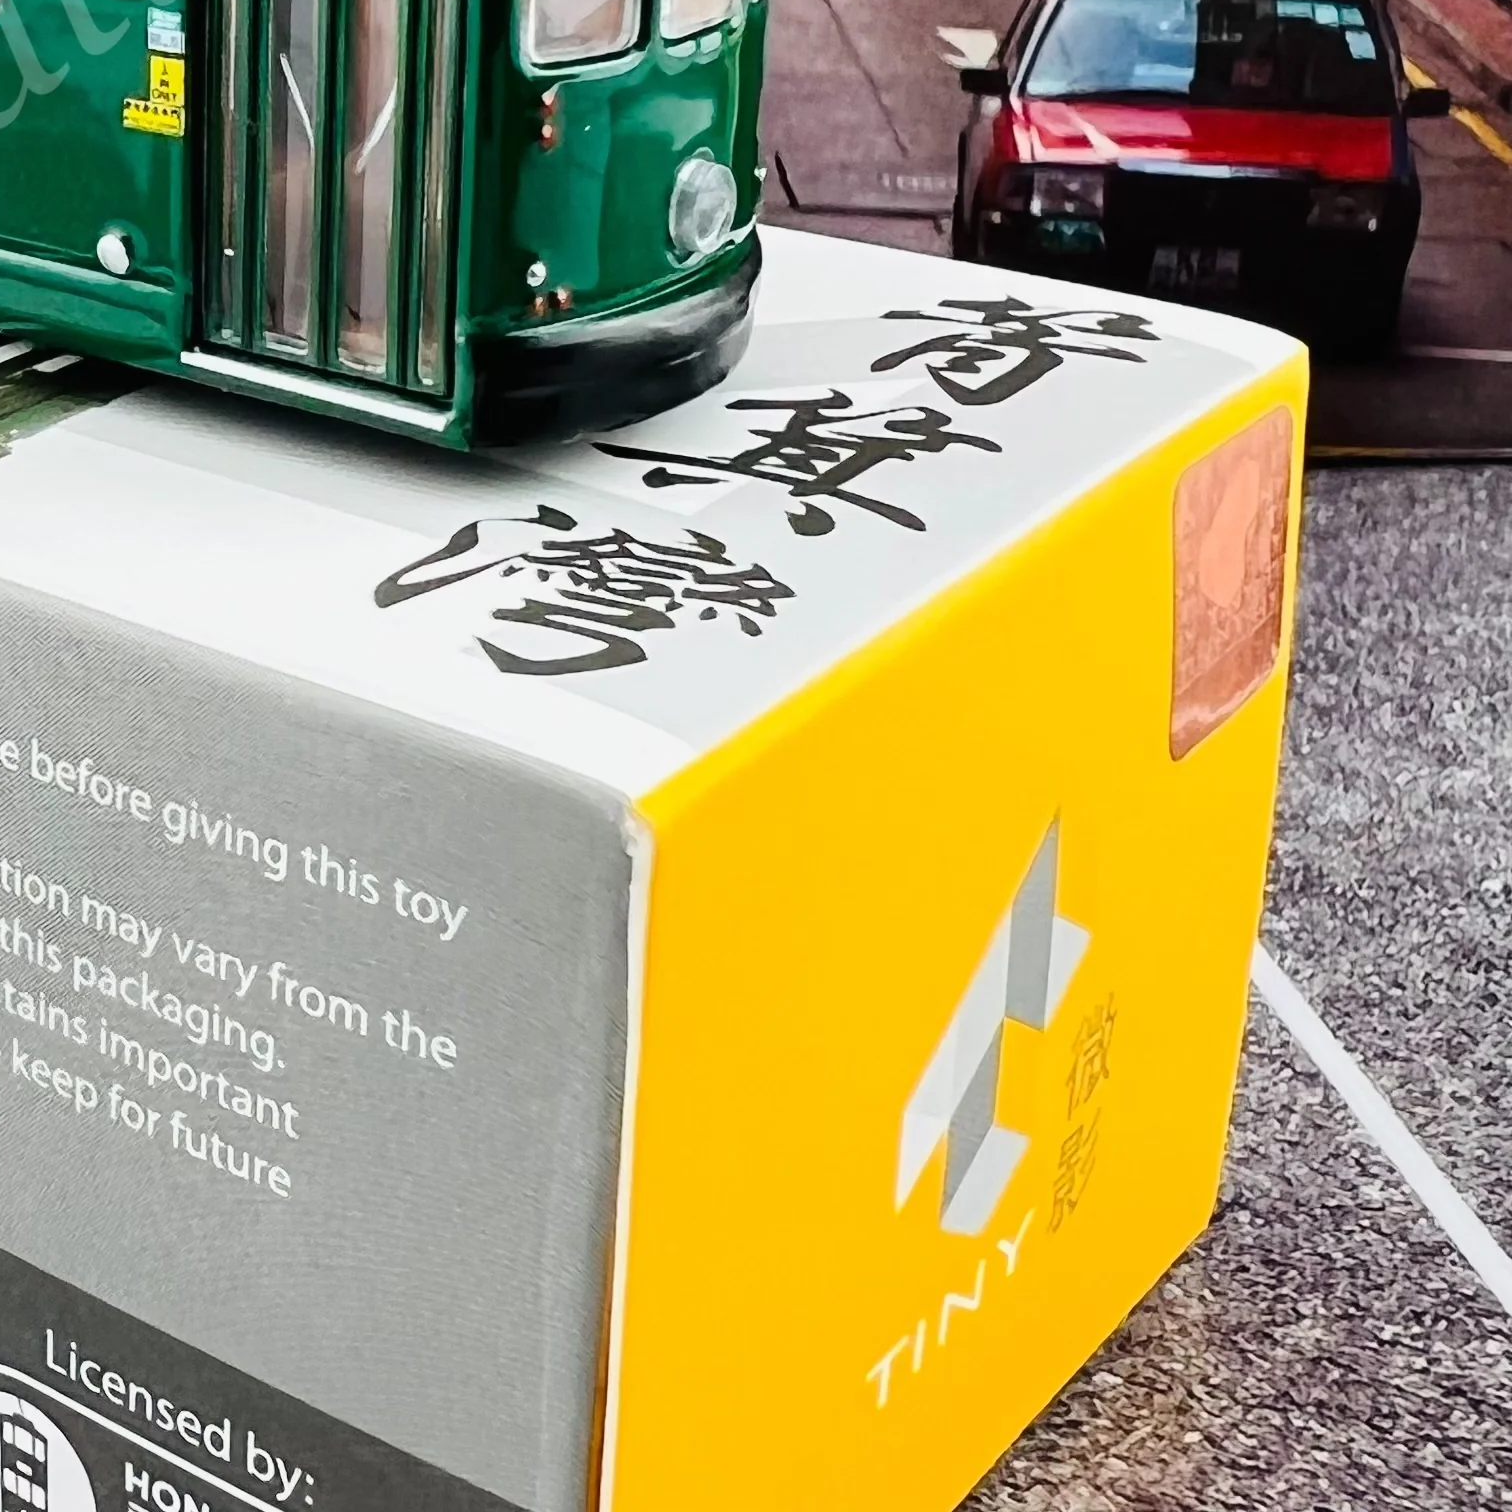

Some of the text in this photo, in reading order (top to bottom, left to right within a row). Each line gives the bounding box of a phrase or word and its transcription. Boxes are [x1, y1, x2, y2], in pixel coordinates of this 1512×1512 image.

[29, 737, 153, 823] before
[162, 797, 290, 882] giving
[300, 843, 381, 906] this
[394, 877, 469, 942] toy
[72, 954, 286, 1073] packaging.
[82, 893, 163, 958] may
[171, 932, 258, 997] vary
[267, 961, 369, 1037] from
[381, 1009, 458, 1070] the
[11, 1037, 99, 1114] keep
[108, 1084, 163, 1141] for
[170, 1110, 291, 1199] future
[99, 1018, 301, 1140] important
[866, 1206, 1037, 1409] TINY
[45, 1328, 315, 1506] Licensed by:
